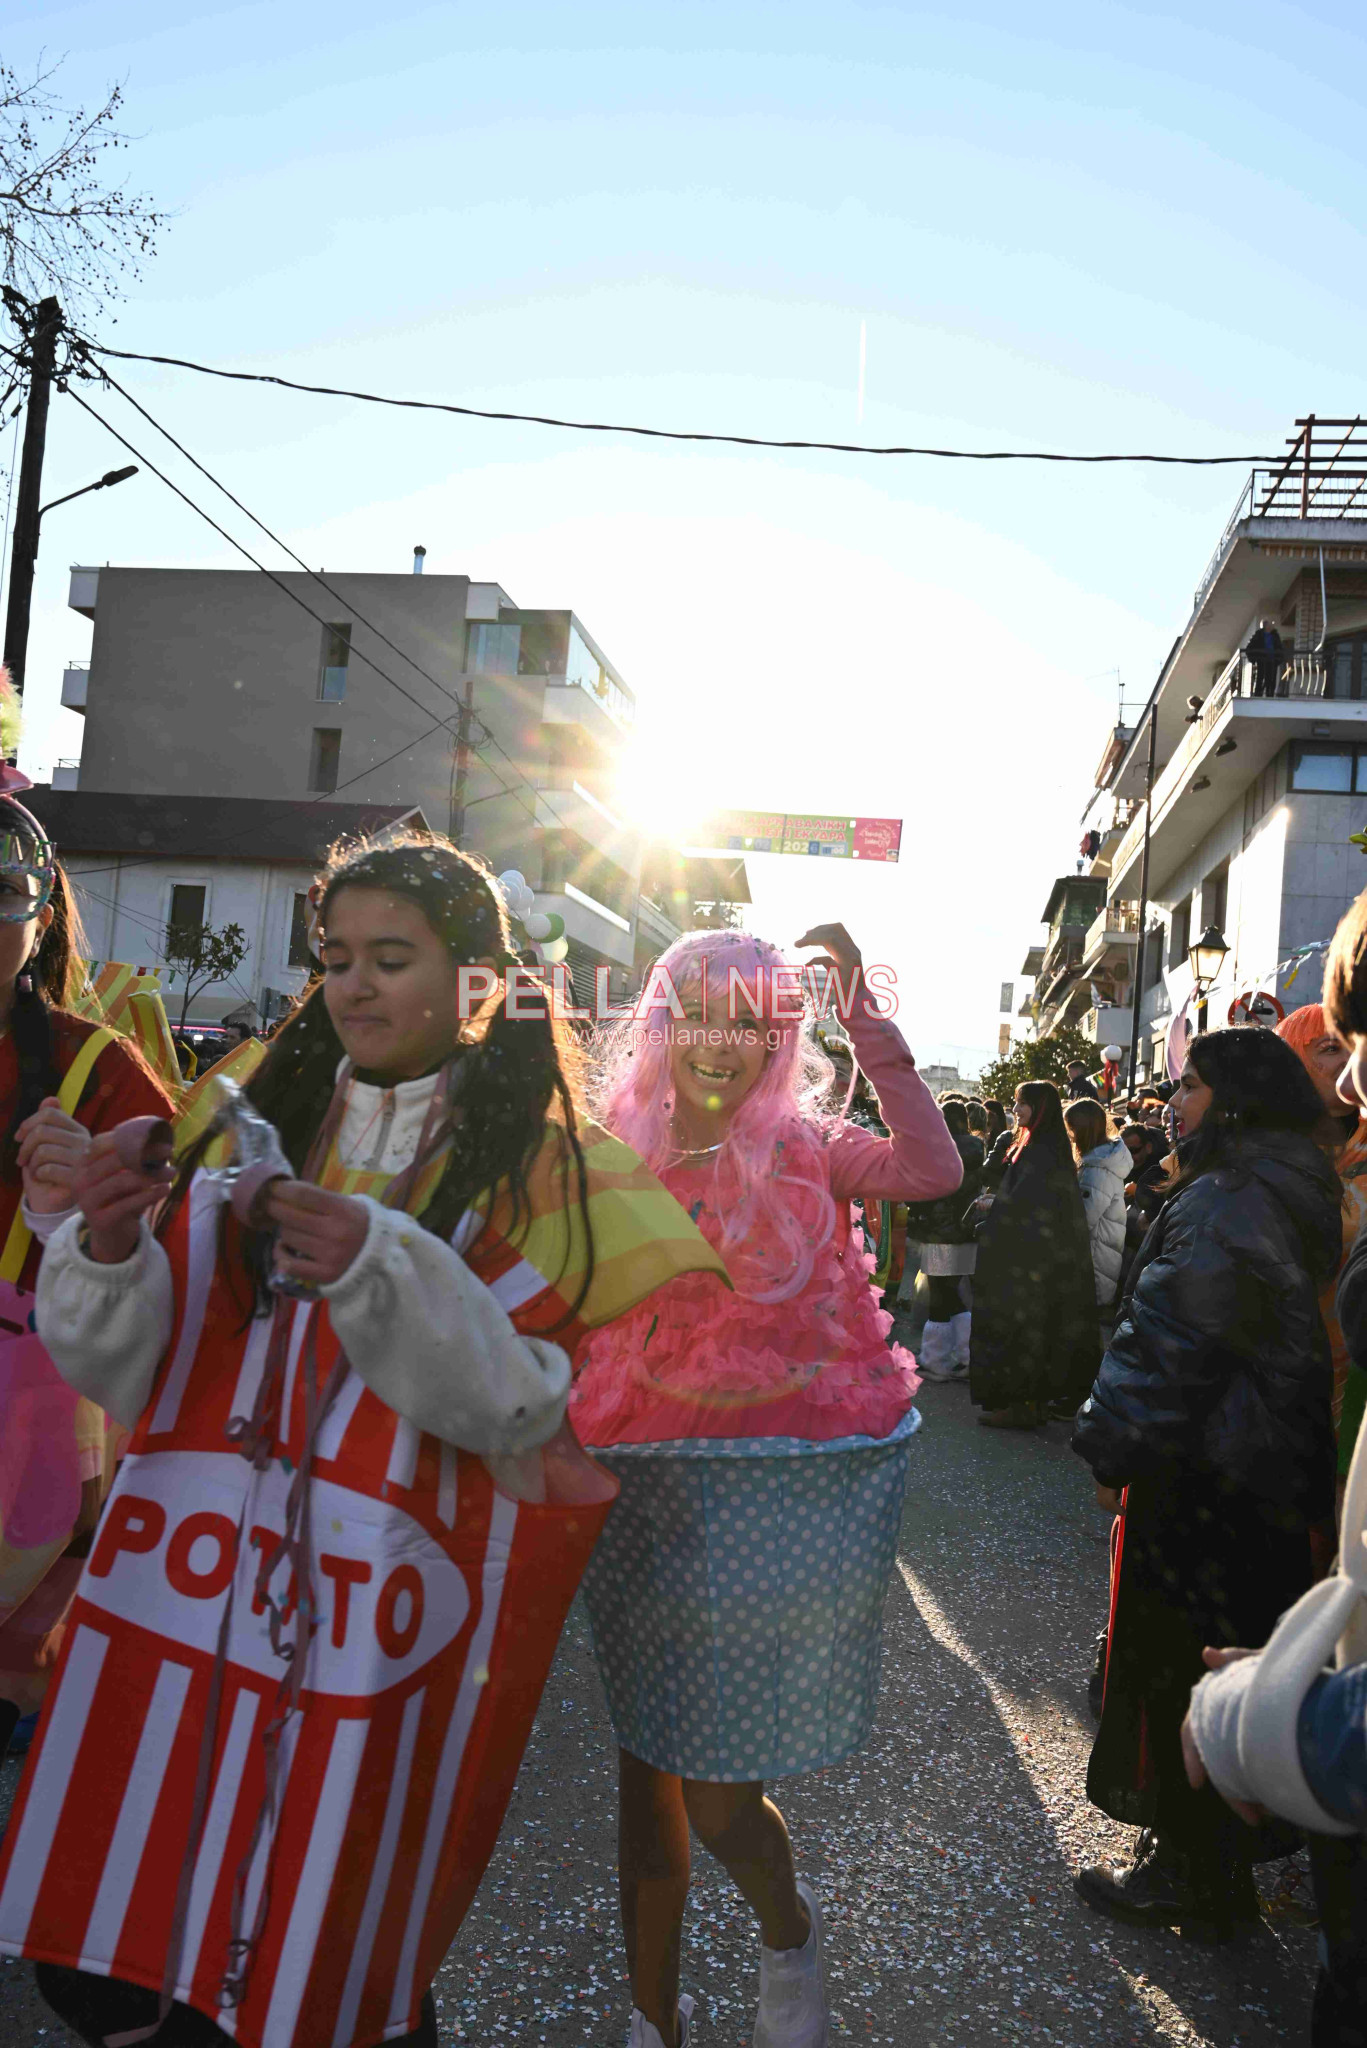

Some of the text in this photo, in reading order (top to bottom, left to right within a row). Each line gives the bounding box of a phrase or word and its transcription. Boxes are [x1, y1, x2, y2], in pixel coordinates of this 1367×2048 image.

[748, 816, 847, 831] ΚΑΡΝΑΒΑΛΙΚΗ
[793, 829, 846, 842] ΣΚΥΔΡΑ
[784, 840, 818, 854] 2026
